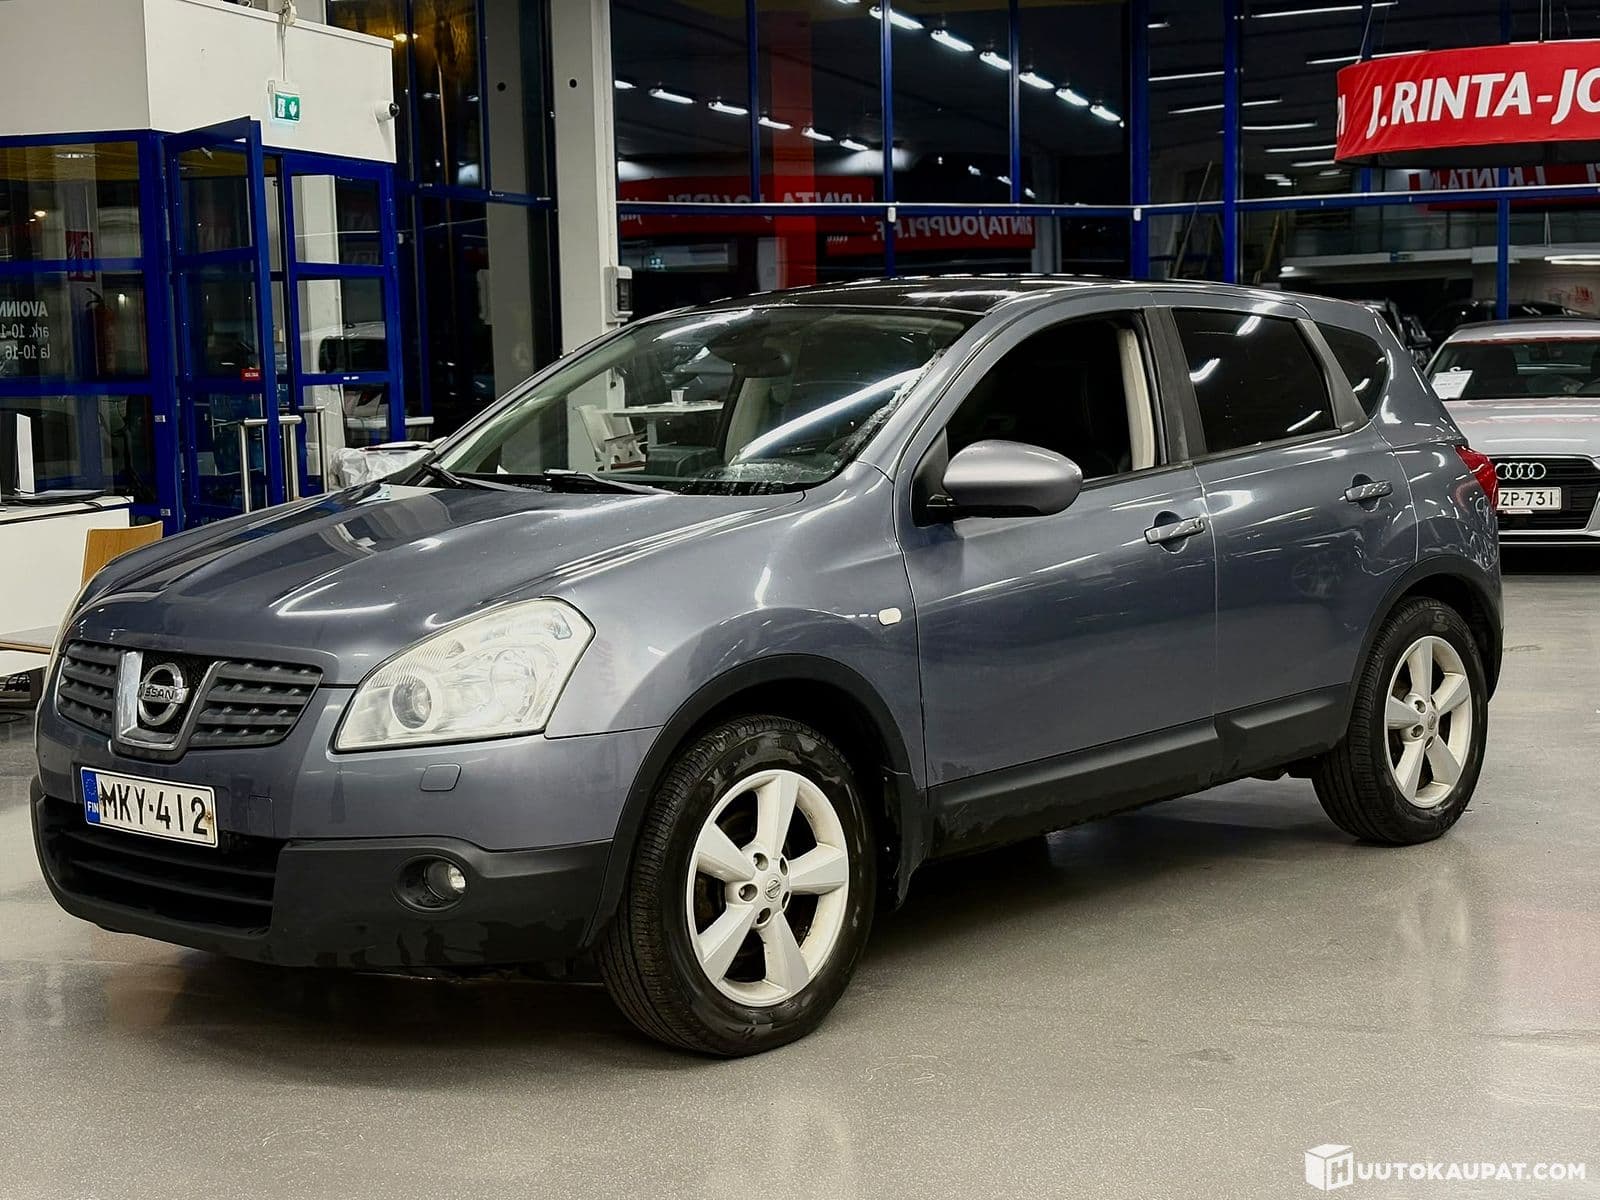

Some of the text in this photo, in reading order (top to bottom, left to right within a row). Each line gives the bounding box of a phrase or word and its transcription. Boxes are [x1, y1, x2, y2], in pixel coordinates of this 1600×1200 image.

[1500, 491, 1553, 506] ZP-731
[87, 801, 100, 814] FIN
[100, 781, 209, 836] MKY-412
